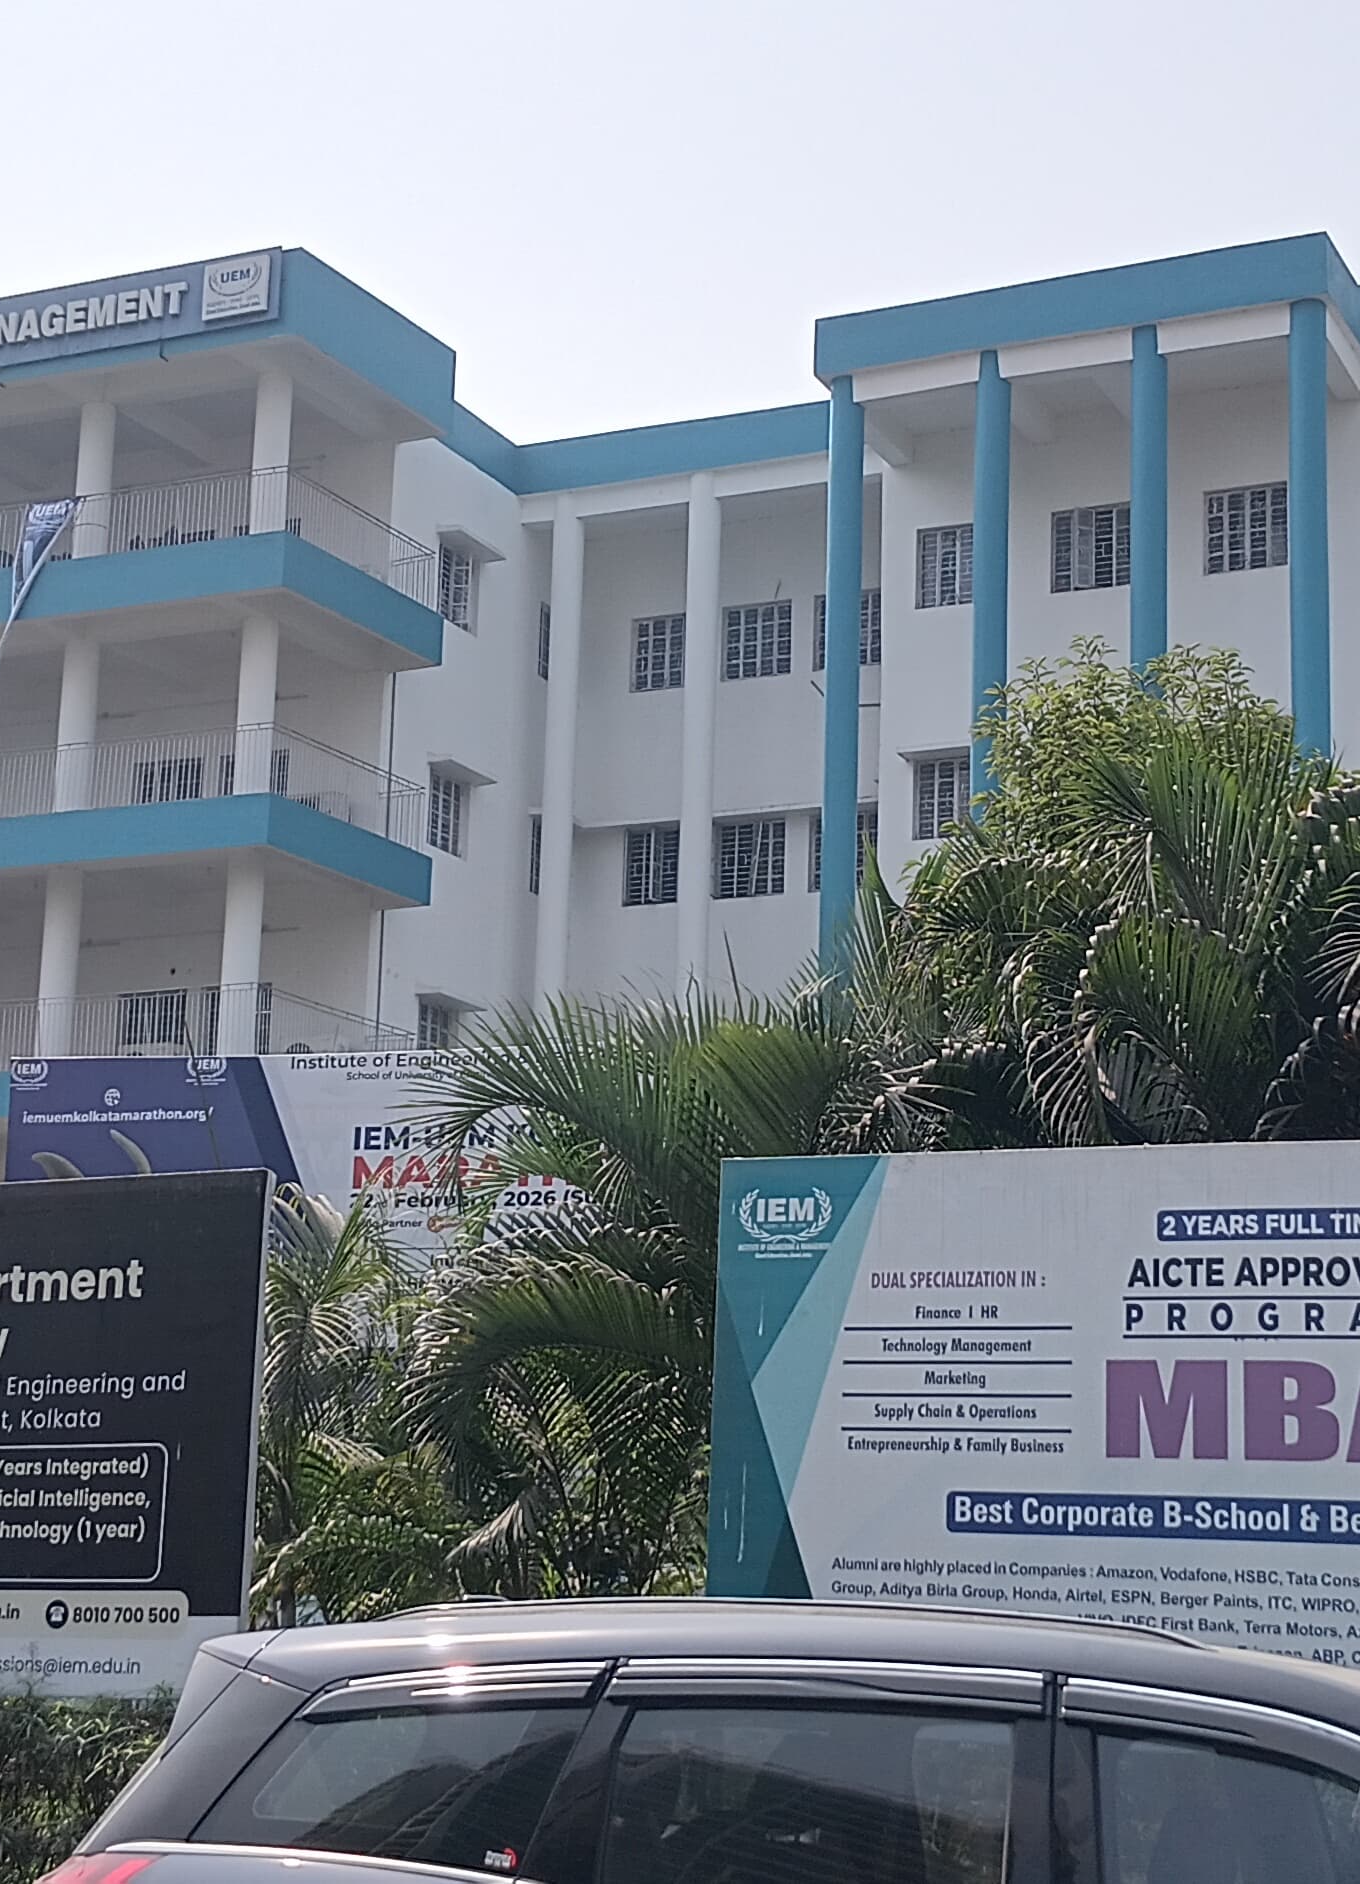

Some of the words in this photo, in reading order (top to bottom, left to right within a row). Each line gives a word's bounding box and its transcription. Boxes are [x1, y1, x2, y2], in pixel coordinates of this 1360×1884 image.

[221, 268, 251, 284] UEM
[17, 1063, 41, 1075] IEM
[290, 1053, 368, 1070] Institute
[372, 1053, 391, 1068] of
[346, 1071, 380, 1081] School
[382, 1070, 392, 1080] of
[504, 1190, 556, 1207] 2026
[757, 1197, 814, 1222] IEM
[1162, 1216, 1176, 1236] 2
[1182, 1214, 1259, 1237] YEARS
[1265, 1214, 1324, 1235] FULL
[871, 1272, 907, 1289] DUAL
[909, 1271, 1017, 1289] SPECIALIZATION
[1021, 1271, 1037, 1287] IN
[1127, 1257, 1225, 1288] AICTE
[915, 1306, 961, 1320] Finance
[980, 1306, 998, 1319] HR
[882, 1339, 947, 1356] Technology
[950, 1338, 1032, 1355] Management
[6, 1372, 135, 1402] Engineering
[142, 1370, 186, 1392] and
[924, 1371, 986, 1388] Marketing
[20, 1408, 102, 1430] Kolkata
[874, 1404, 913, 1421] Supply
[917, 1404, 952, 1418] Chain
[956, 1405, 965, 1418] &
[969, 1405, 1037, 1421] Operations
[847, 1436, 950, 1454] Entrepreneurship
[953, 1437, 962, 1451] &
[967, 1438, 1007, 1455] Family
[1010, 1438, 1064, 1454] Business
[46, 1452, 149, 1479] Integrated)
[38, 1488, 151, 1512] Intelligence,
[954, 1496, 1013, 1524] Best
[1022, 1497, 1153, 1532] Corporate
[1163, 1500, 1290, 1532] B-School
[1299, 1505, 1320, 1532] &
[77, 1516, 93, 1543] (1
[94, 1516, 146, 1543] year)
[832, 1558, 879, 1573] Alumni
[880, 1561, 901, 1573] are
[903, 1560, 945, 1577] highly
[947, 1561, 991, 1577] placed
[993, 1562, 1007, 1575] in
[1009, 1562, 1086, 1580] Companies
[1096, 1565, 1158, 1582] Amazon,
[1160, 1566, 1231, 1584] Vodafone,
[1234, 1569, 1283, 1586] HSBC,
[1286, 1571, 1318, 1586] Tata
[832, 1581, 876, 1597] Group,
[880, 1581, 922, 1599] Aditya
[926, 1583, 958, 1597] Birla
[961, 1584, 1008, 1601] Group,
[1013, 1588, 1061, 1603] Honda,
[1065, 1589, 1106, 1605] Airtel,
[1111, 1590, 1156, 1607] ESPN,
[1160, 1592, 1209, 1609] Berger
[1213, 1594, 1263, 1611] Paints,
[1267, 1596, 1297, 1612] ITC,
[1301, 1598, 1360, 1615] WIPRO,
[73, 1607, 109, 1623] 8010
[114, 1607, 143, 1623] 700
[148, 1607, 180, 1623] 500
[1161, 1617, 1194, 1632] First
[1198, 1619, 1239, 1634] Bank,
[1244, 1620, 1281, 1635] Terra
[1286, 1622, 1342, 1638] Motors,
